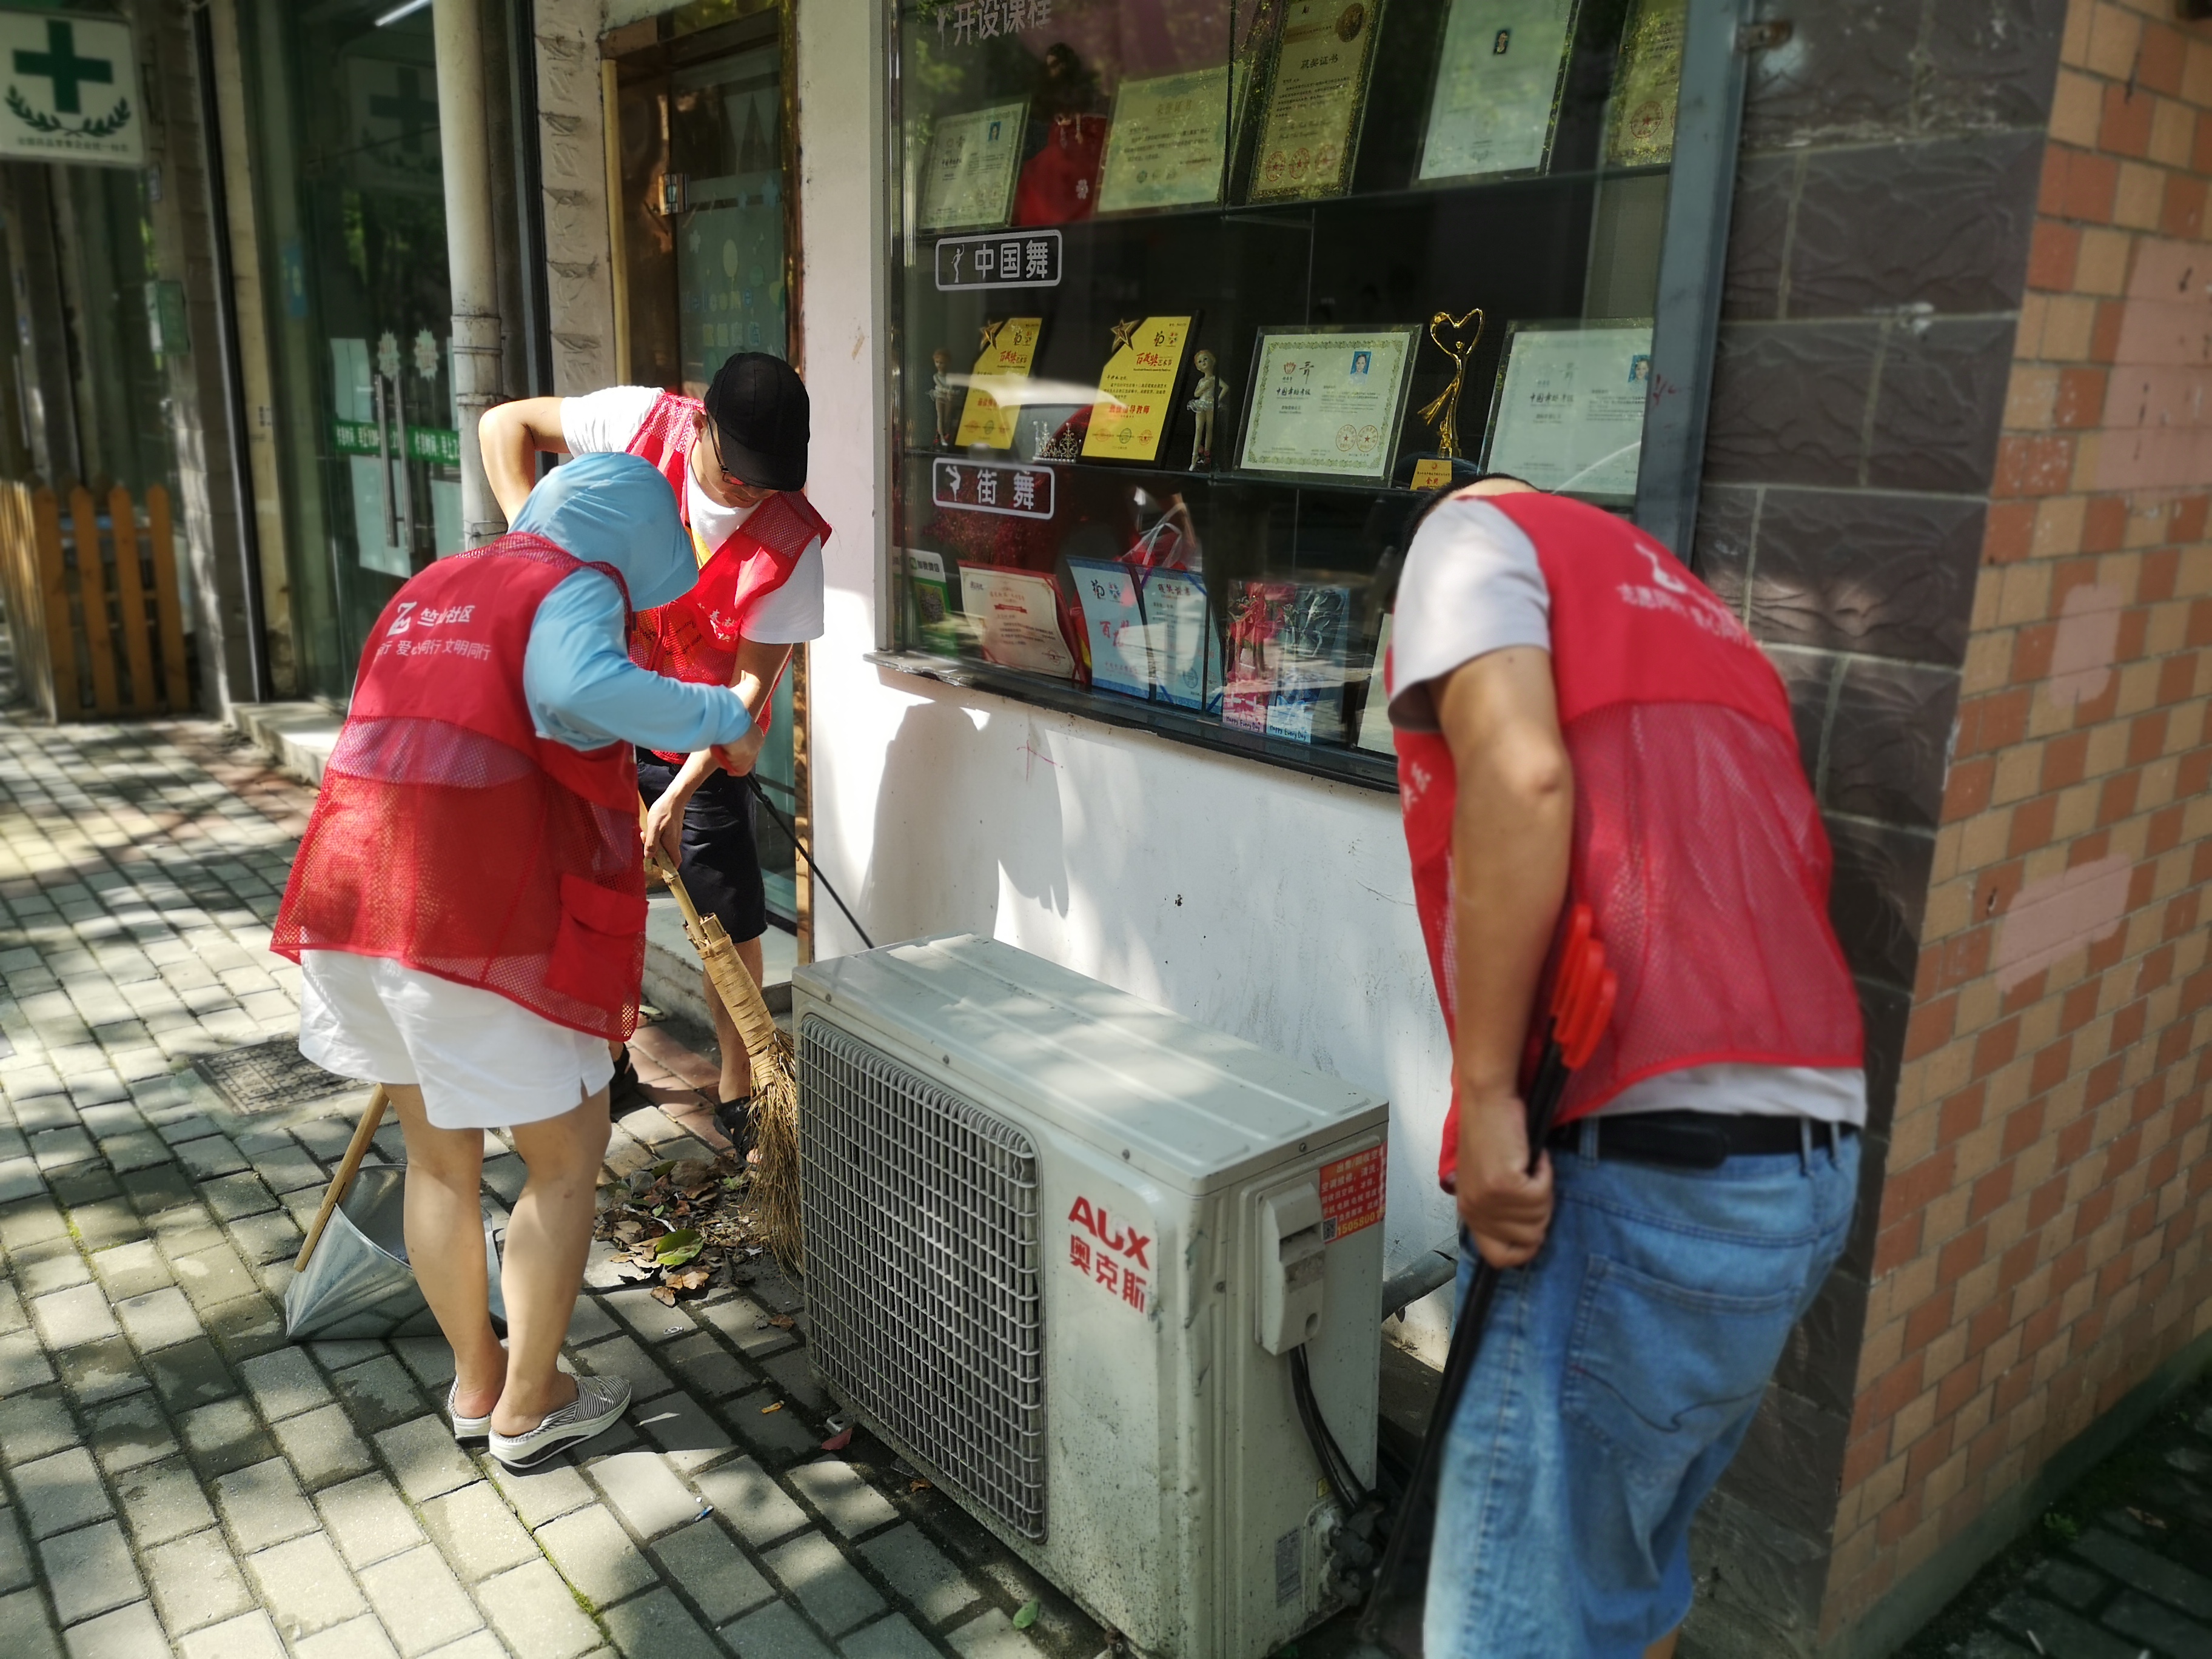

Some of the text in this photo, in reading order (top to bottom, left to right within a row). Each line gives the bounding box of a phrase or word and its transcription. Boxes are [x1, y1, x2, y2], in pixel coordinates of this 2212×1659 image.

[974, 239, 1048, 279] 中国舞
[977, 469, 1034, 510] 街舞
[917, 560, 940, 573] 加我微信
[442, 638, 491, 661] 文明同行
[1226, 716, 1238, 725] Happy
[1240, 719, 1252, 730] Every
[1270, 725, 1307, 741] Happy Every Day
[1068, 1196, 1151, 1271] AUX
[1070, 1234, 1147, 1313] 奥克斯
